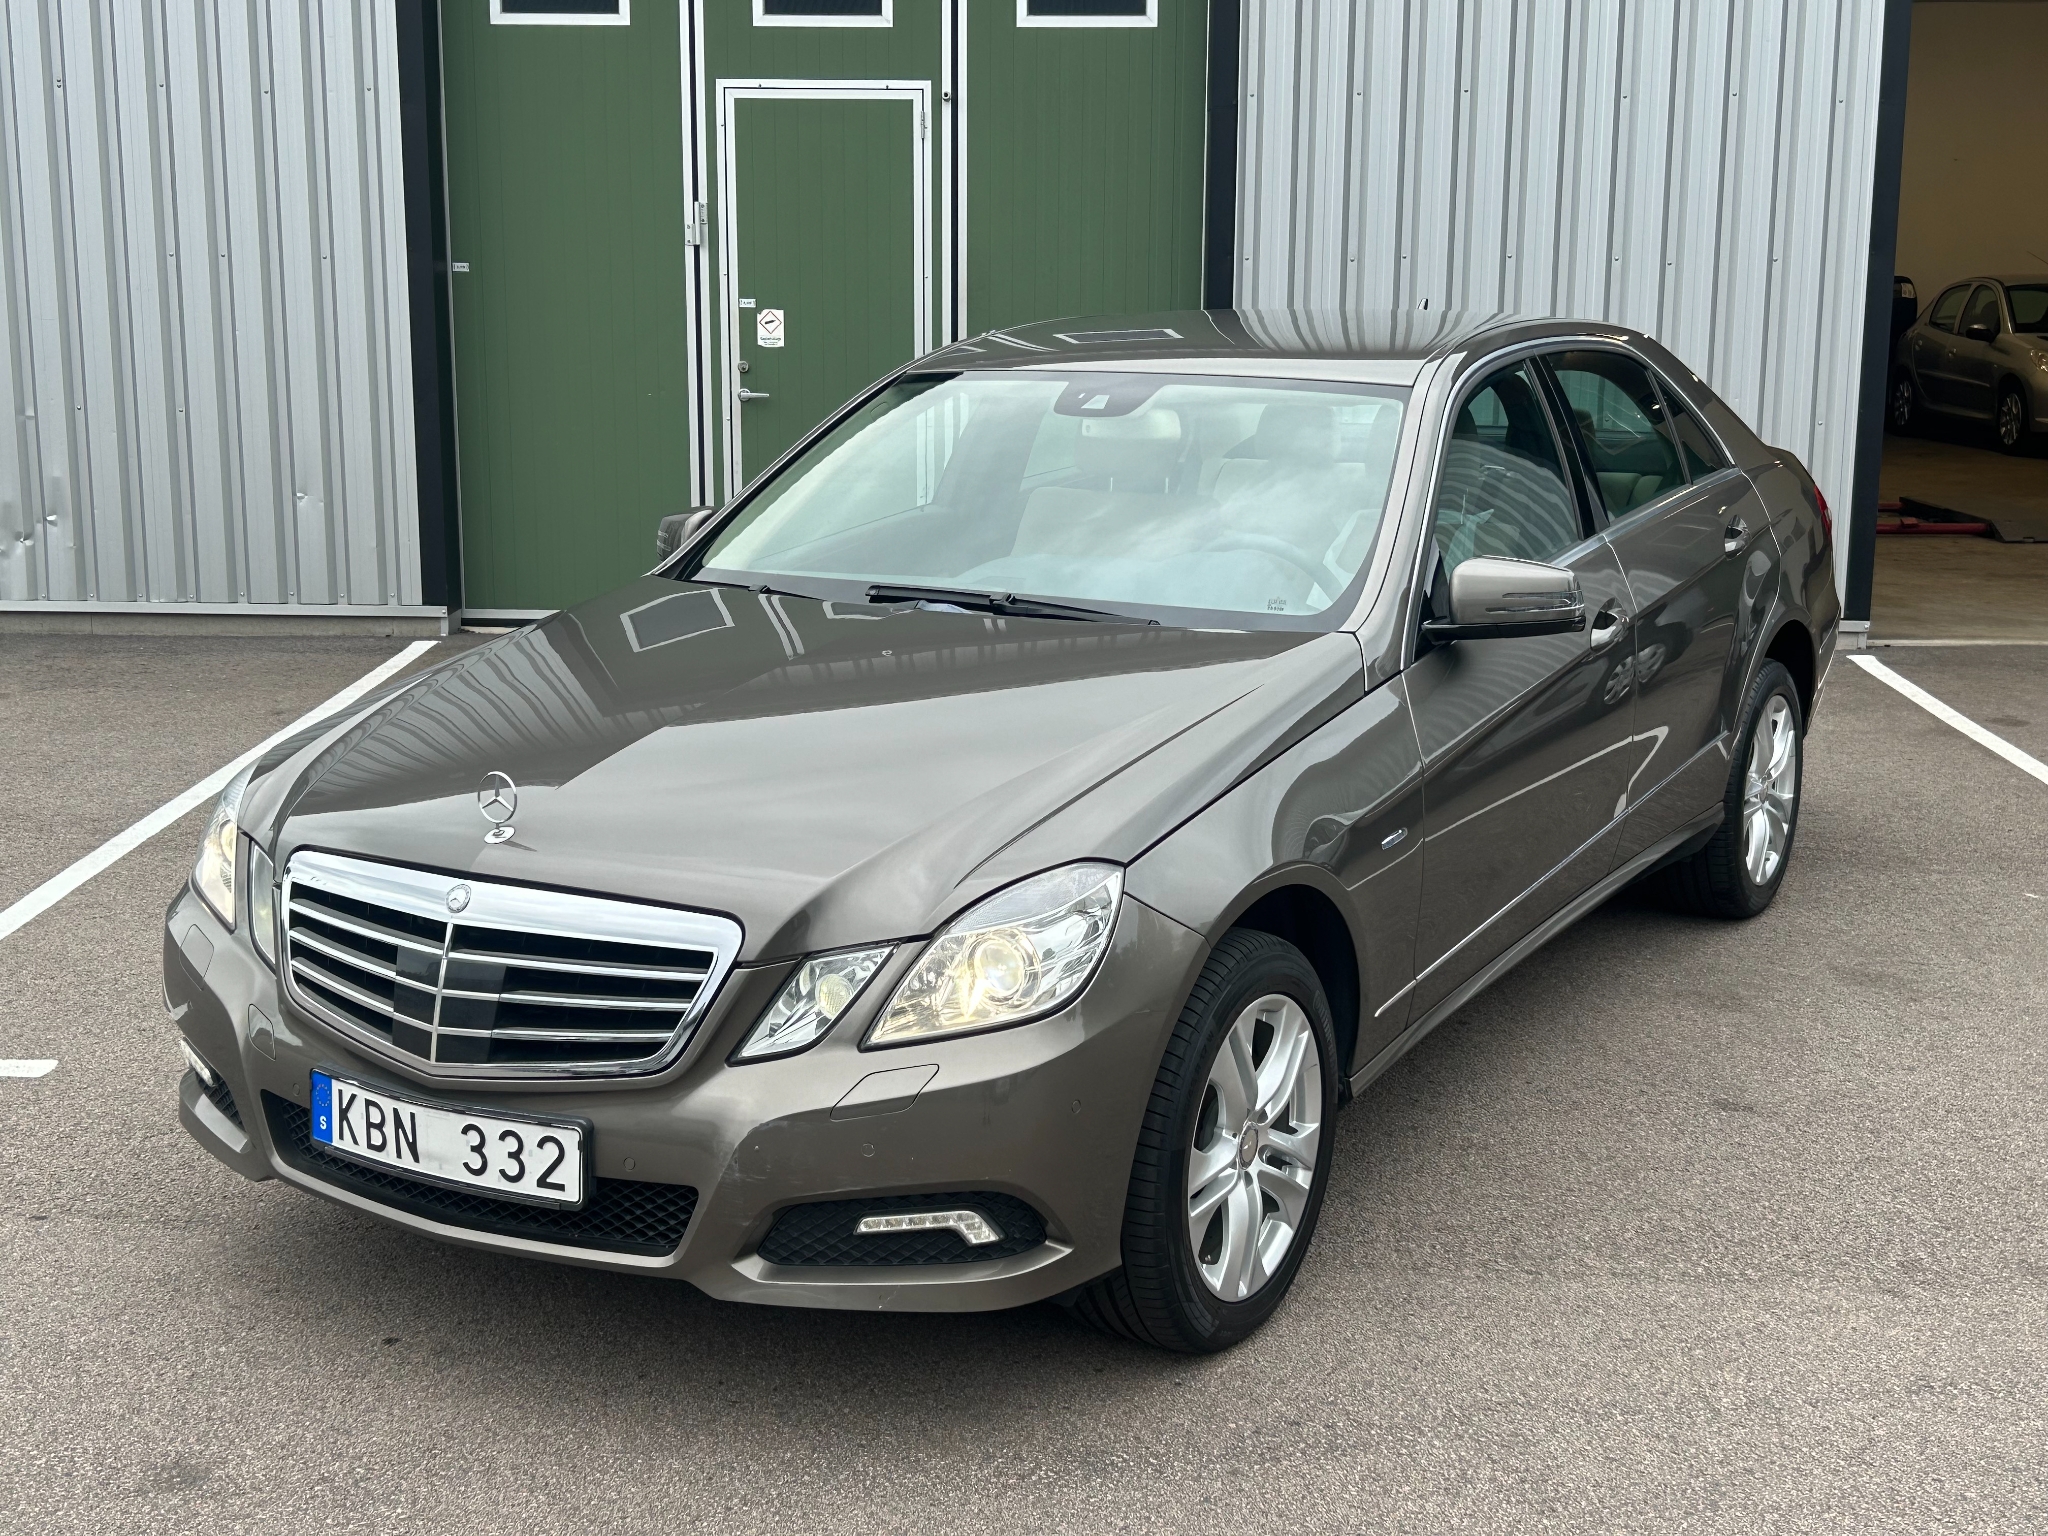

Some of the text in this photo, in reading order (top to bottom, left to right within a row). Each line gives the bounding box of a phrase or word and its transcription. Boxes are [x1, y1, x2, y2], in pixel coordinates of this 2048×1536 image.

[319, 1115, 327, 1130] S
[337, 1088, 566, 1192] KBN 332
